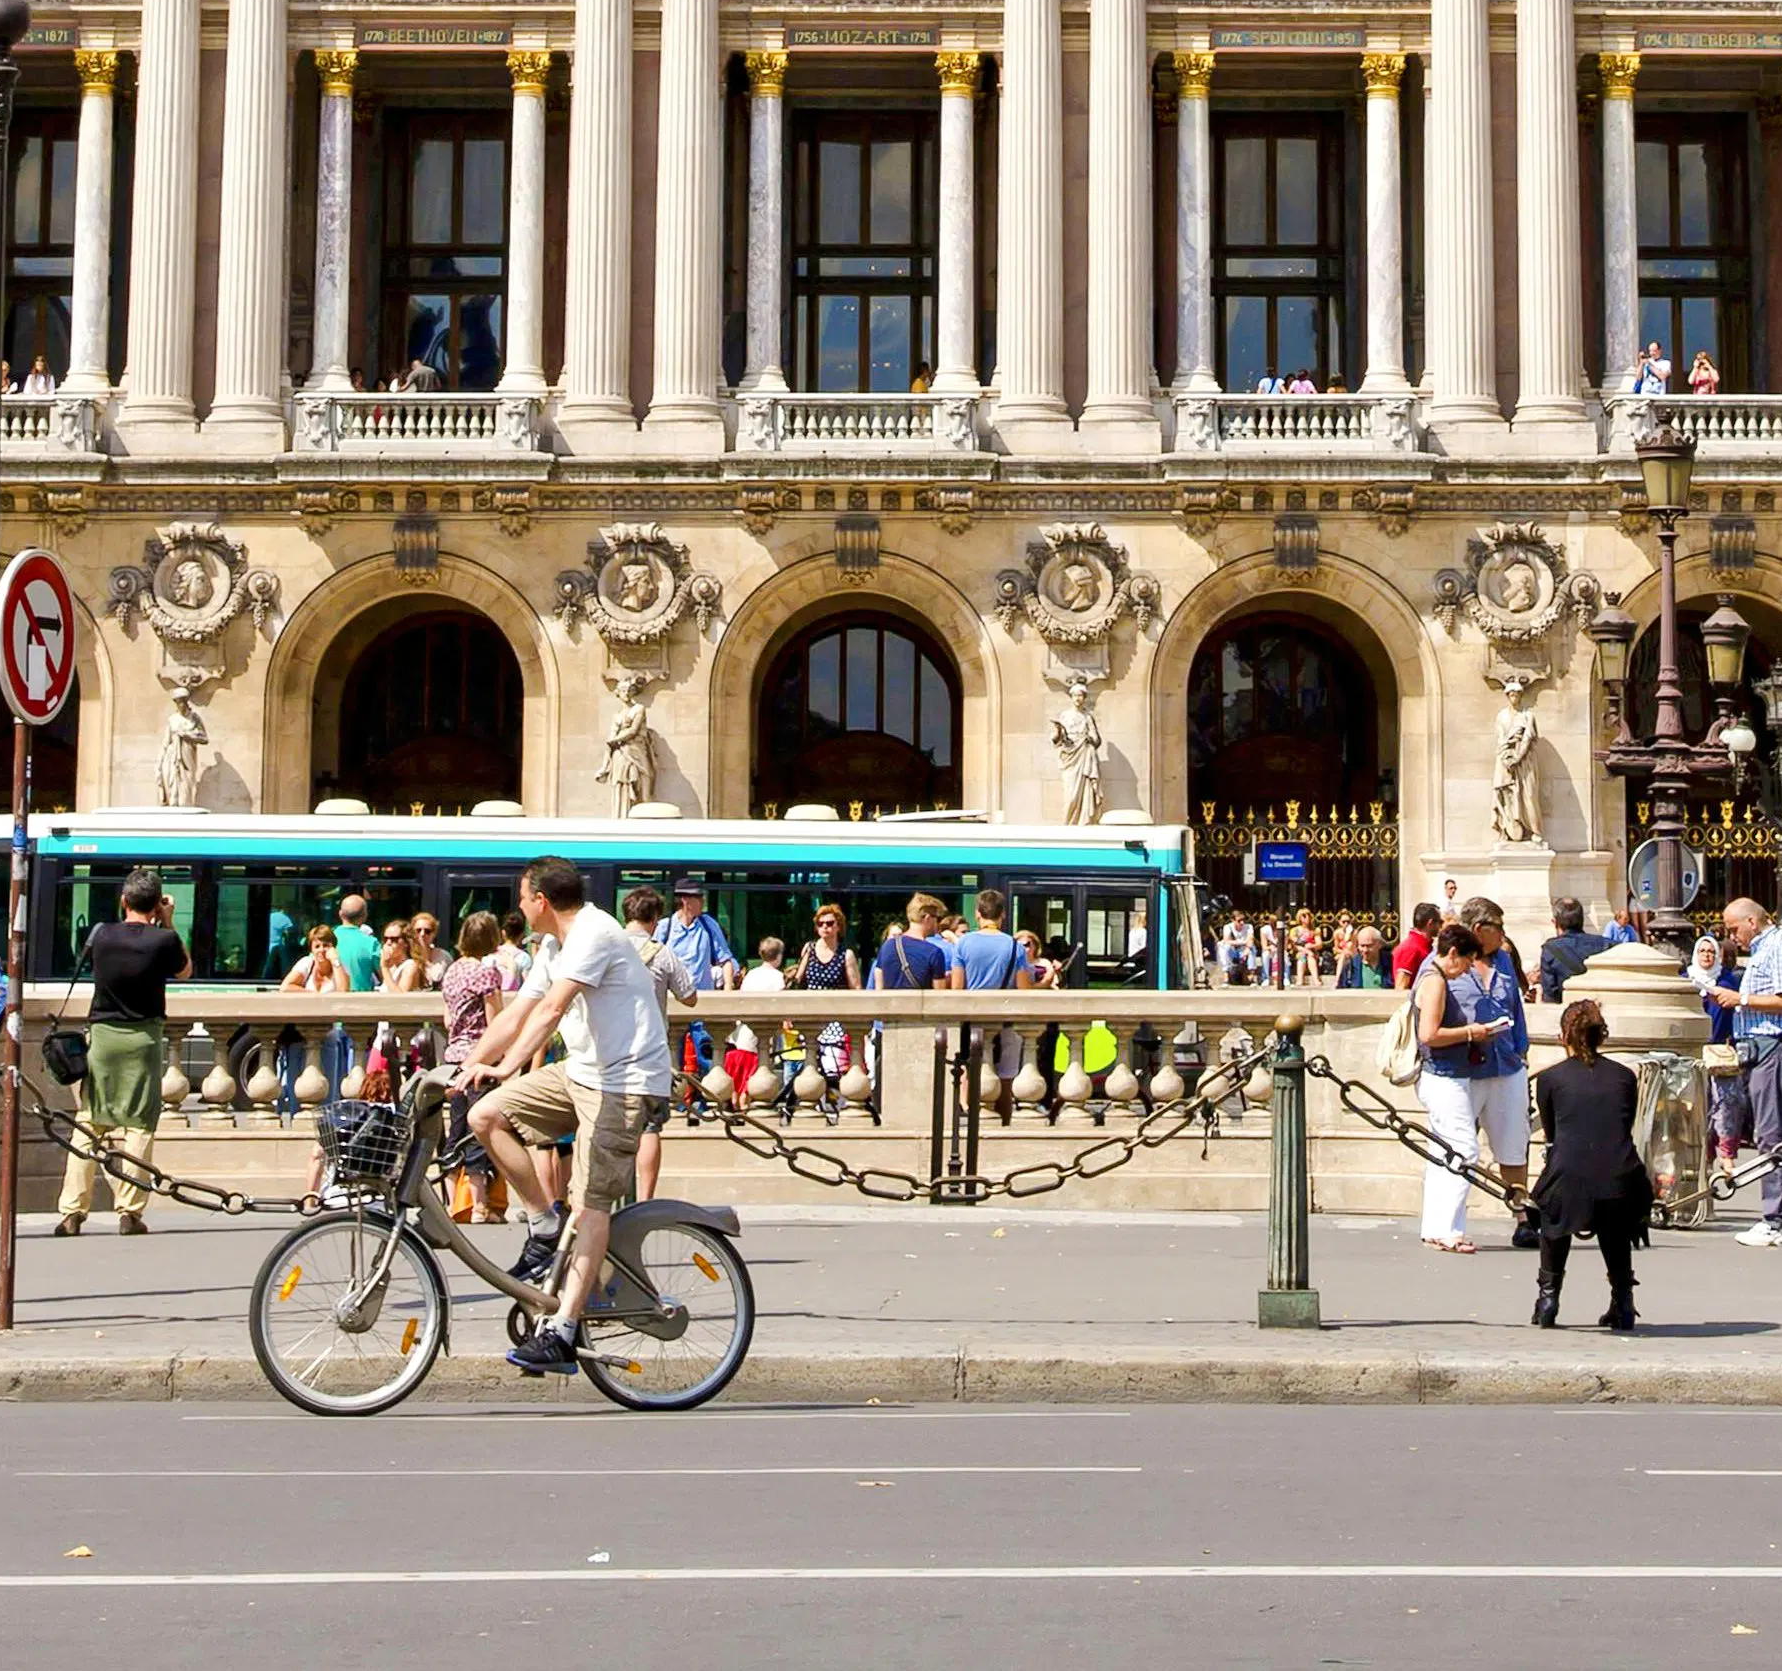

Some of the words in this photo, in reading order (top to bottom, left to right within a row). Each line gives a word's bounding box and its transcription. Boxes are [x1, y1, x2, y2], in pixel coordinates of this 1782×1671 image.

[45, 30, 69, 43] 1871
[388, 29, 478, 43] BEETHOVEN
[794, 32, 819, 44] 1756
[825, 30, 900, 45] MOZART
[910, 32, 931, 44] 1791
